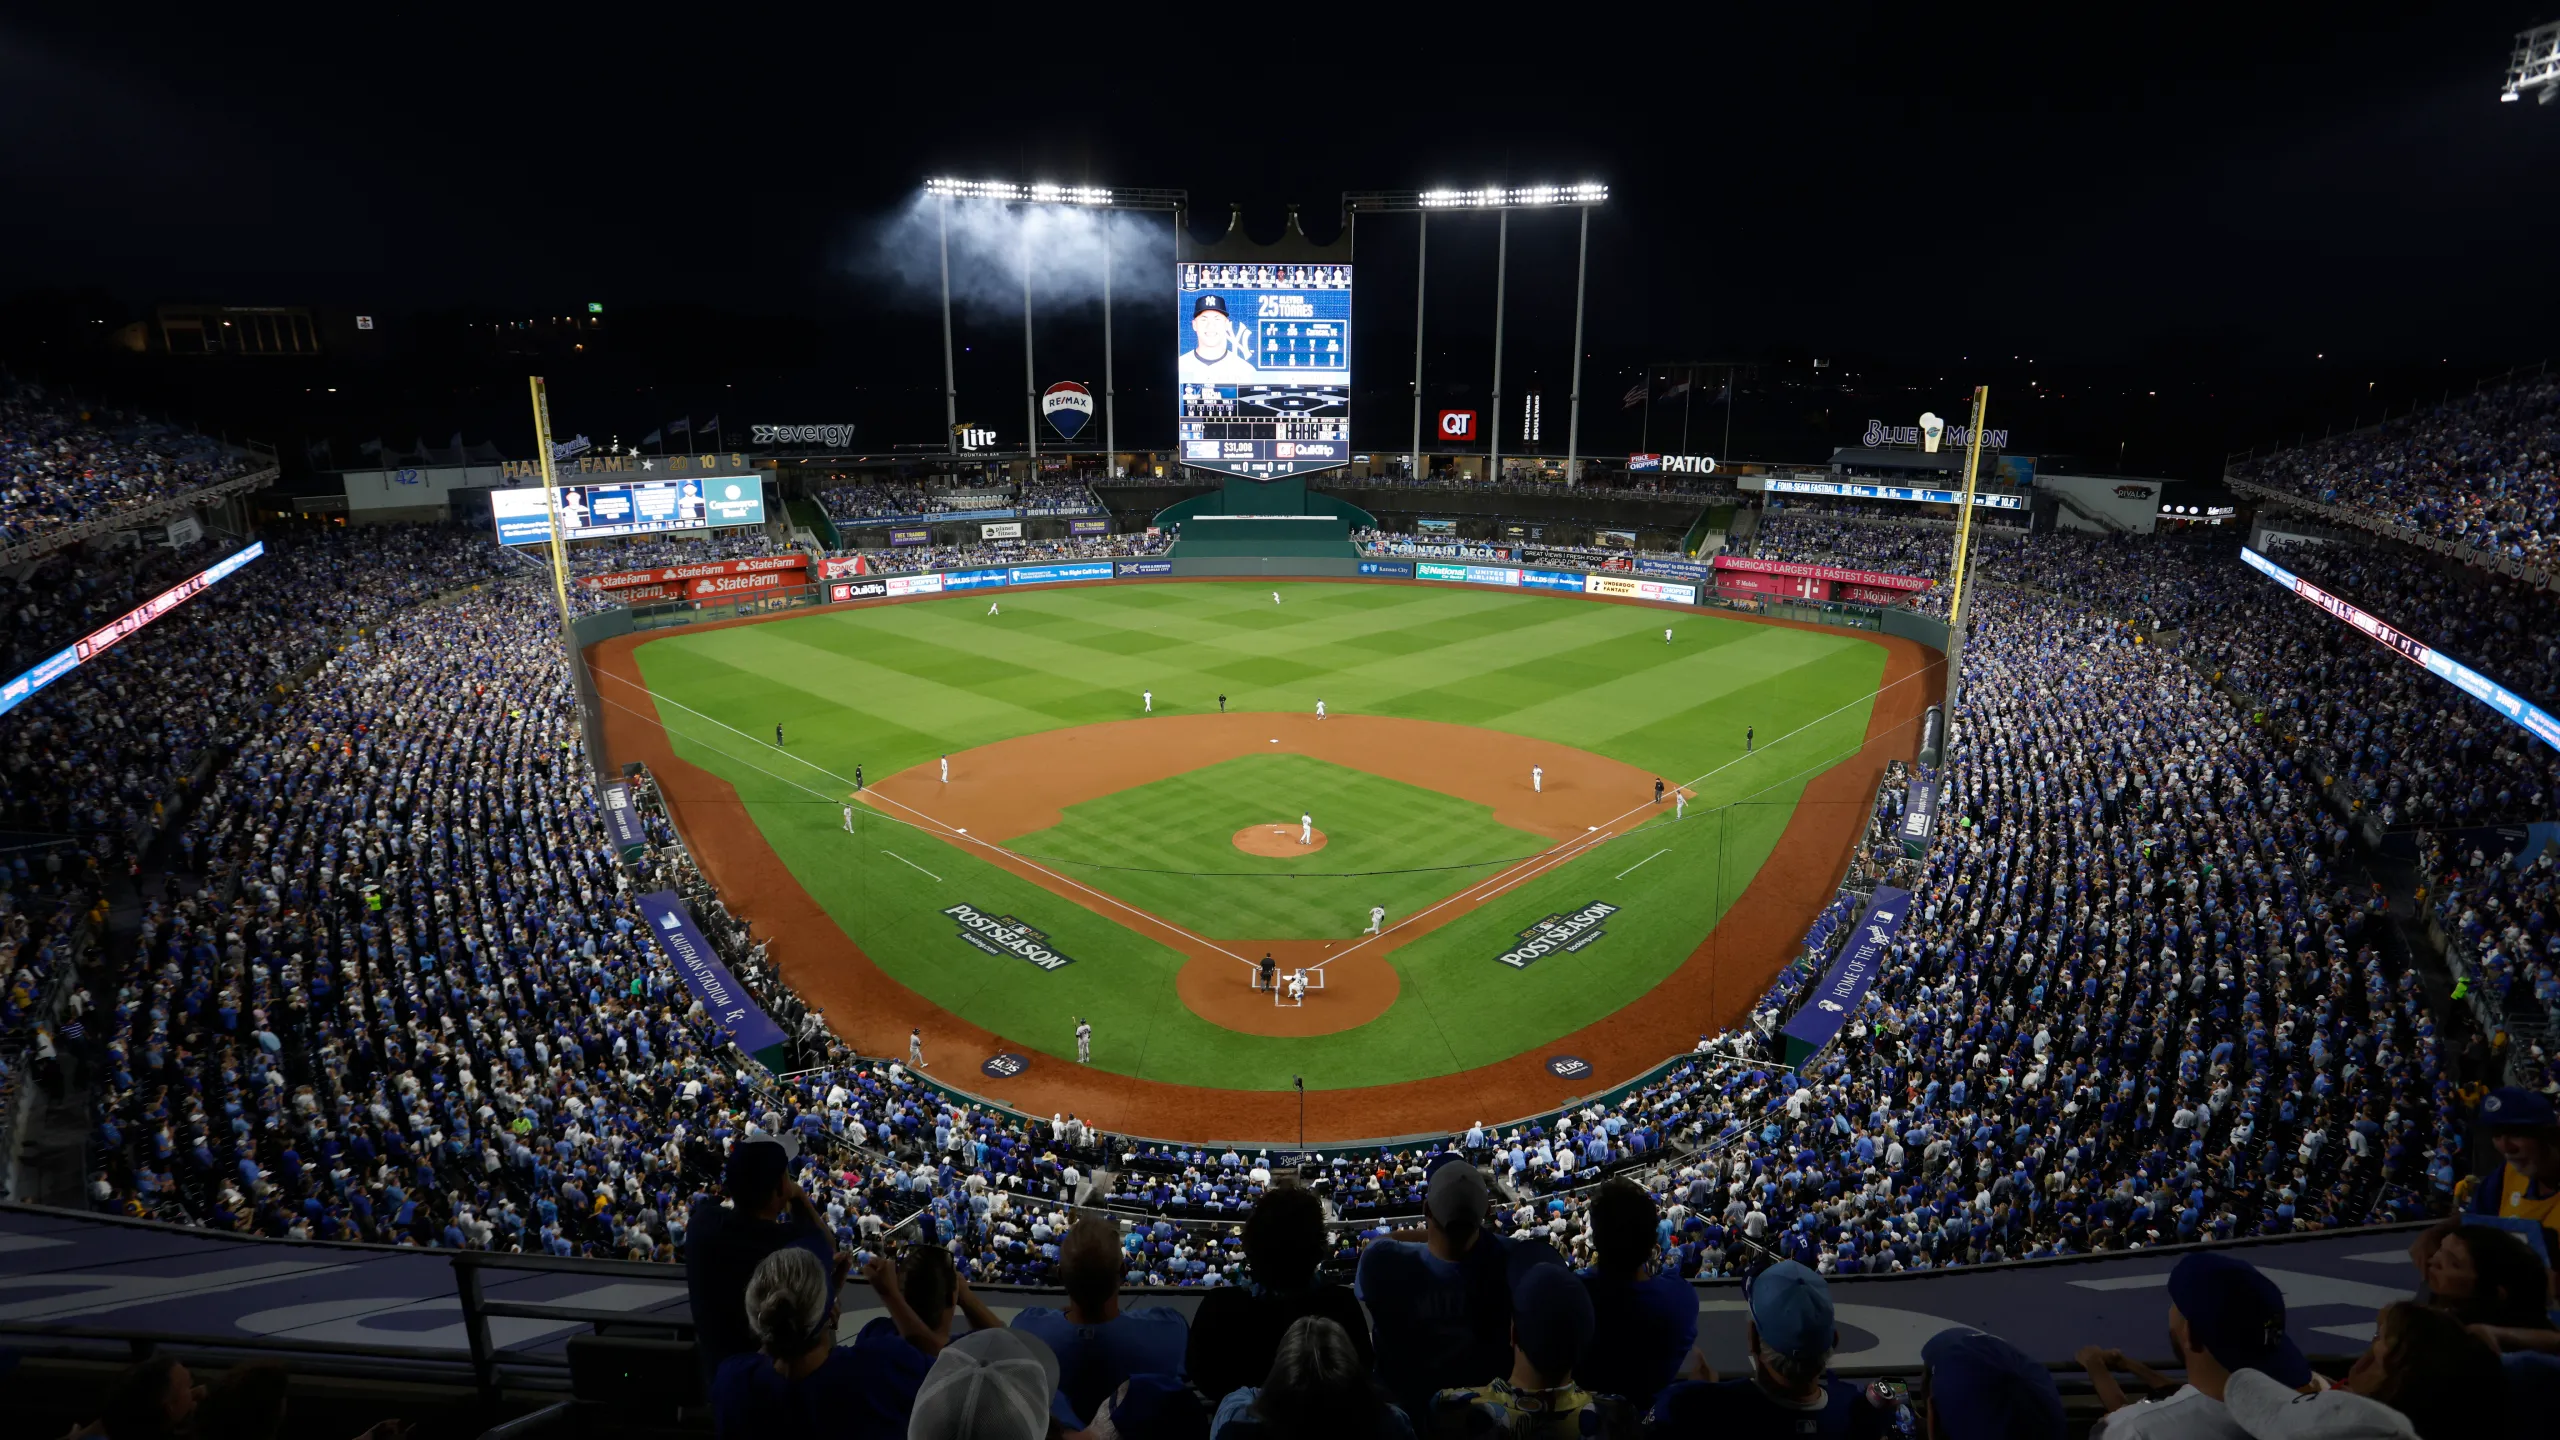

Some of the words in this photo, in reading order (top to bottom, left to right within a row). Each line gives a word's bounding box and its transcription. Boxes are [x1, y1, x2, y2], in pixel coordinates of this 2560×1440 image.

[1187, 265, 1195, 274] AT
[1210, 266, 1218, 275] 22
[1229, 266, 1237, 275] 99
[1248, 266, 1256, 276] 28
[1267, 266, 1275, 276] 27
[1286, 266, 1294, 276] 13
[1307, 267, 1312, 276] 11
[1323, 267, 1332, 277] 24
[1343, 267, 1351, 277] 19
[1185, 273, 1197, 282] BAT
[1258, 296, 1278, 317] 25
[1278, 304, 1313, 317] TORRES
[1049, 396, 1087, 407] RE/MAX
[1523, 395, 1531, 441] BOULEVARD
[1532, 395, 1540, 441] BOULEVARD
[1442, 413, 1471, 435] QT
[778, 424, 855, 447] evergy
[1863, 419, 1919, 447] BLUE
[1945, 425, 2008, 448] MOON
[962, 429, 997, 451] Lite
[551, 434, 591, 459] Royals
[1295, 444, 1334, 457] QuikTrip
[669, 457, 687, 470] 20
[700, 455, 715, 469] 10
[731, 453, 741, 467] 5
[1631, 454, 1649, 463] PRICE
[502, 461, 542, 478] HAL
[561, 461, 579, 477] of
[580, 456, 635, 473] FAME
[1242, 462, 1249, 473] 0
[1267, 462, 1274, 473] 0
[1287, 462, 1294, 473] 0
[1630, 460, 1659, 471] CHOPPER
[1662, 456, 1715, 474] PATIO
[394, 468, 418, 485] 42
[1777, 481, 1810, 492] FOUR-SEAM
[1810, 483, 1839, 494] FASTBALL
[1853, 487, 1862, 495] 94
[1889, 489, 1897, 497] 16
[1926, 492, 1931, 500] 7
[2117, 489, 2147, 499] RIVALS
[1026, 508, 1049, 516] BROWN
[1390, 543, 1456, 557] FOUNTAIN
[1460, 547, 1497, 560] DECK
[1545, 551, 1563, 559] VIEWS
[830, 564, 853, 573] SONIC
[1069, 569, 1082, 577] Right
[1429, 566, 1466, 577] National
[1726, 559, 1772, 572] AMERICA'S
[1773, 564, 1813, 576] LARGEST
[1814, 568, 1821, 577] &
[1823, 569, 1862, 582] FASTEST
[1863, 574, 1876, 584] 5G
[1878, 576, 1925, 589] NETWORK
[955, 576, 970, 584] ALDS
[1603, 581, 1635, 589] UNDERDOG
[1741, 580, 1758, 588] Mobile
[835, 587, 847, 598] QT
[1603, 586, 1629, 594] FANTASY
[1663, 587, 1692, 596] CHOPPER
[1863, 590, 1896, 602] Mobile
[607, 787, 627, 810] UMB
[1904, 812, 1926, 836] UMB
[1001, 917, 1016, 925] 20
[1028, 931, 1045, 940] 24
[1520, 930, 1536, 938] 20
[944, 904, 1067, 970] POSTSEASON
[1499, 902, 1617, 967] POSTSEASON
[962, 932, 999, 955] Booking.com
[1566, 930, 1603, 952] Booking.com
[668, 931, 703, 972] KAUFFMAN
[695, 964, 733, 1008] STADIUM
[1832, 969, 1860, 999] HOME
[1848, 959, 1866, 976] OF
[1861, 944, 1877, 963] THE
[1556, 1060, 1584, 1074] ALDS
[1130, 1238, 1136, 1247] 5
[1800, 1237, 1808, 1249] 13
